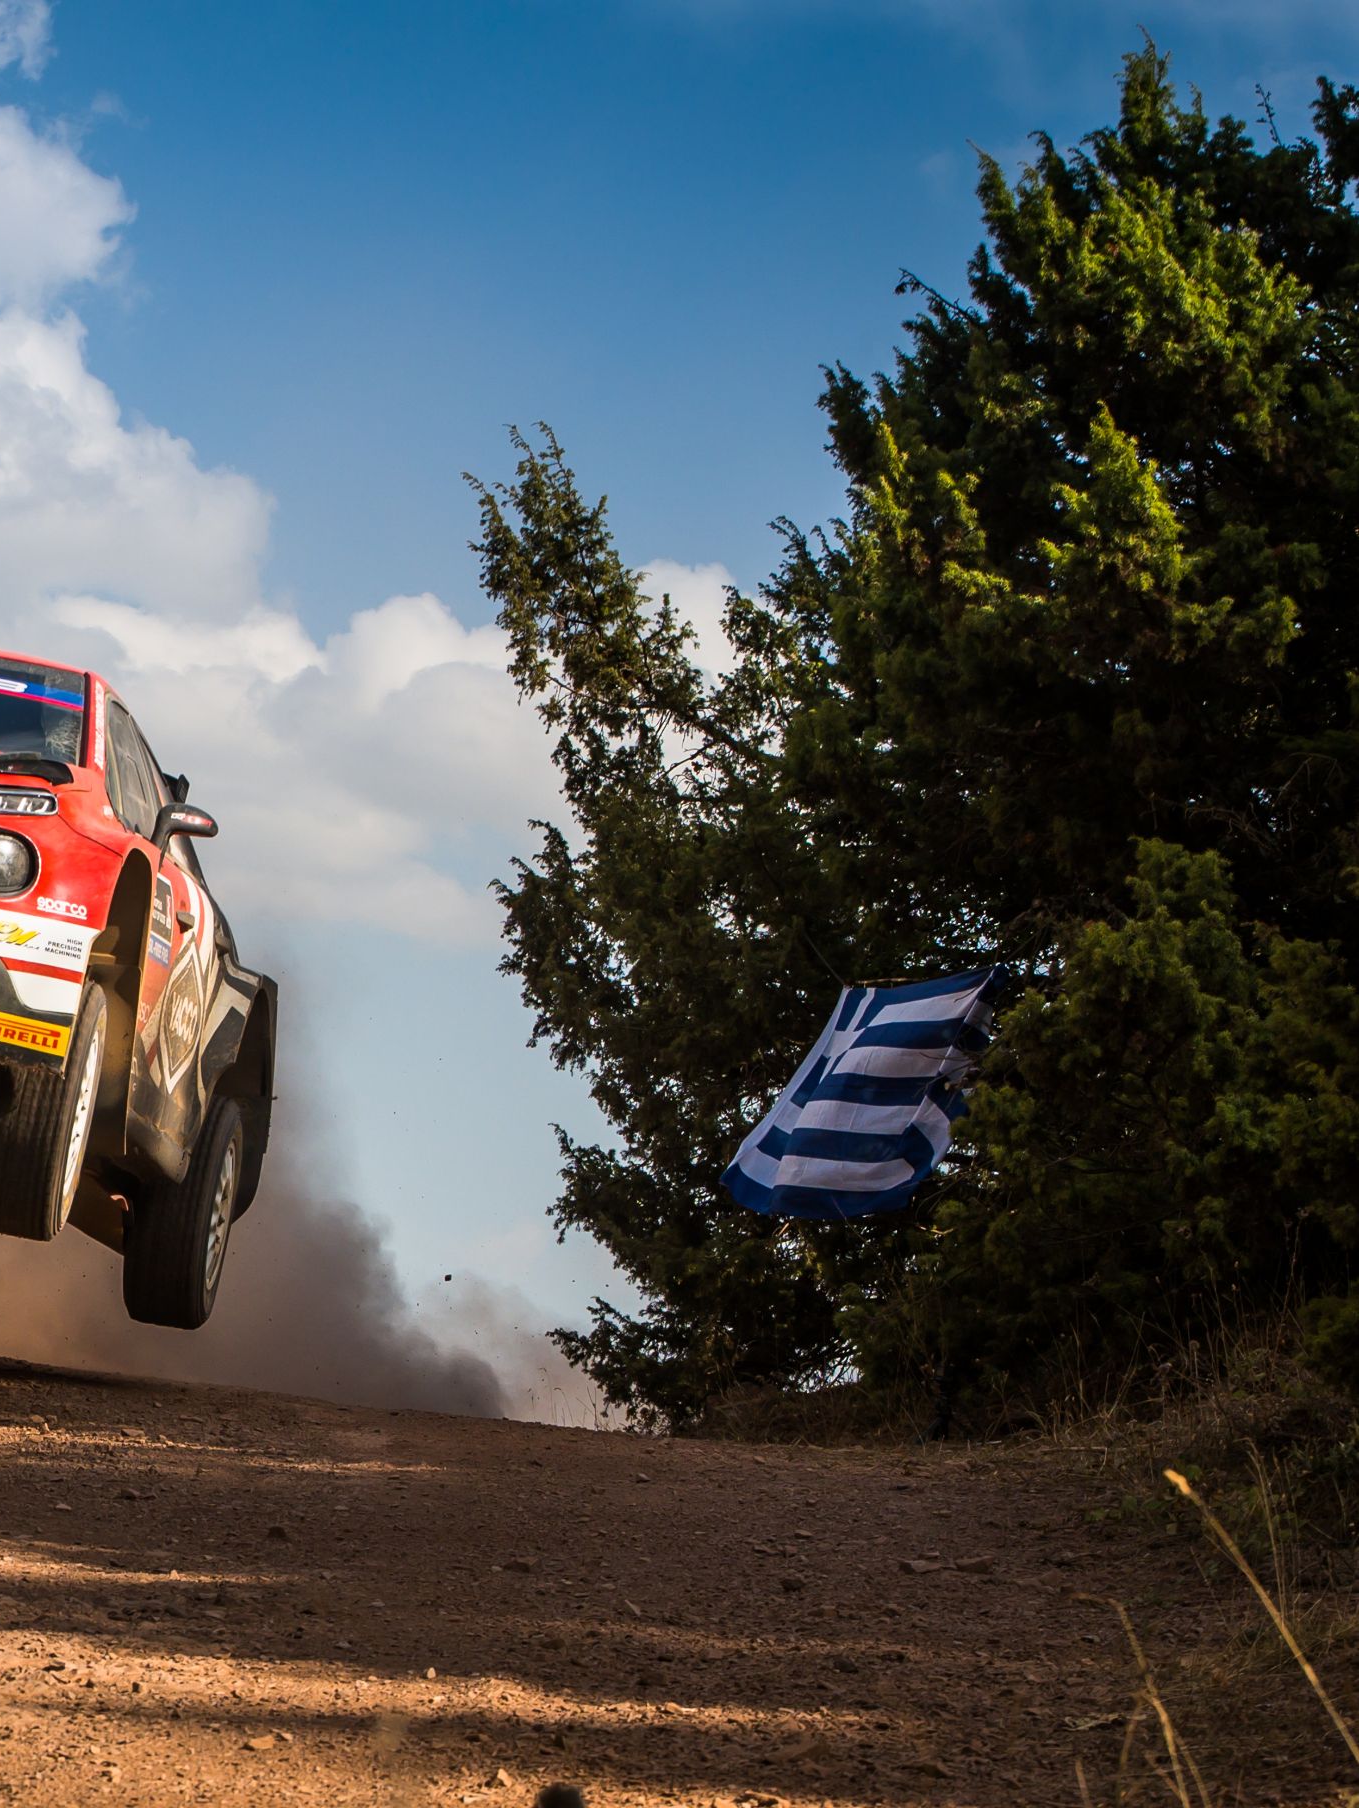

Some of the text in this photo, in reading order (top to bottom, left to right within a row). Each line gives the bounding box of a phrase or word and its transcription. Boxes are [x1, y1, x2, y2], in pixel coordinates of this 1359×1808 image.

[37, 896, 88, 917] sparco
[47, 940, 82, 953] PRECISION
[66, 938, 83, 946] HIGH
[43, 947, 81, 960] MACHINING
